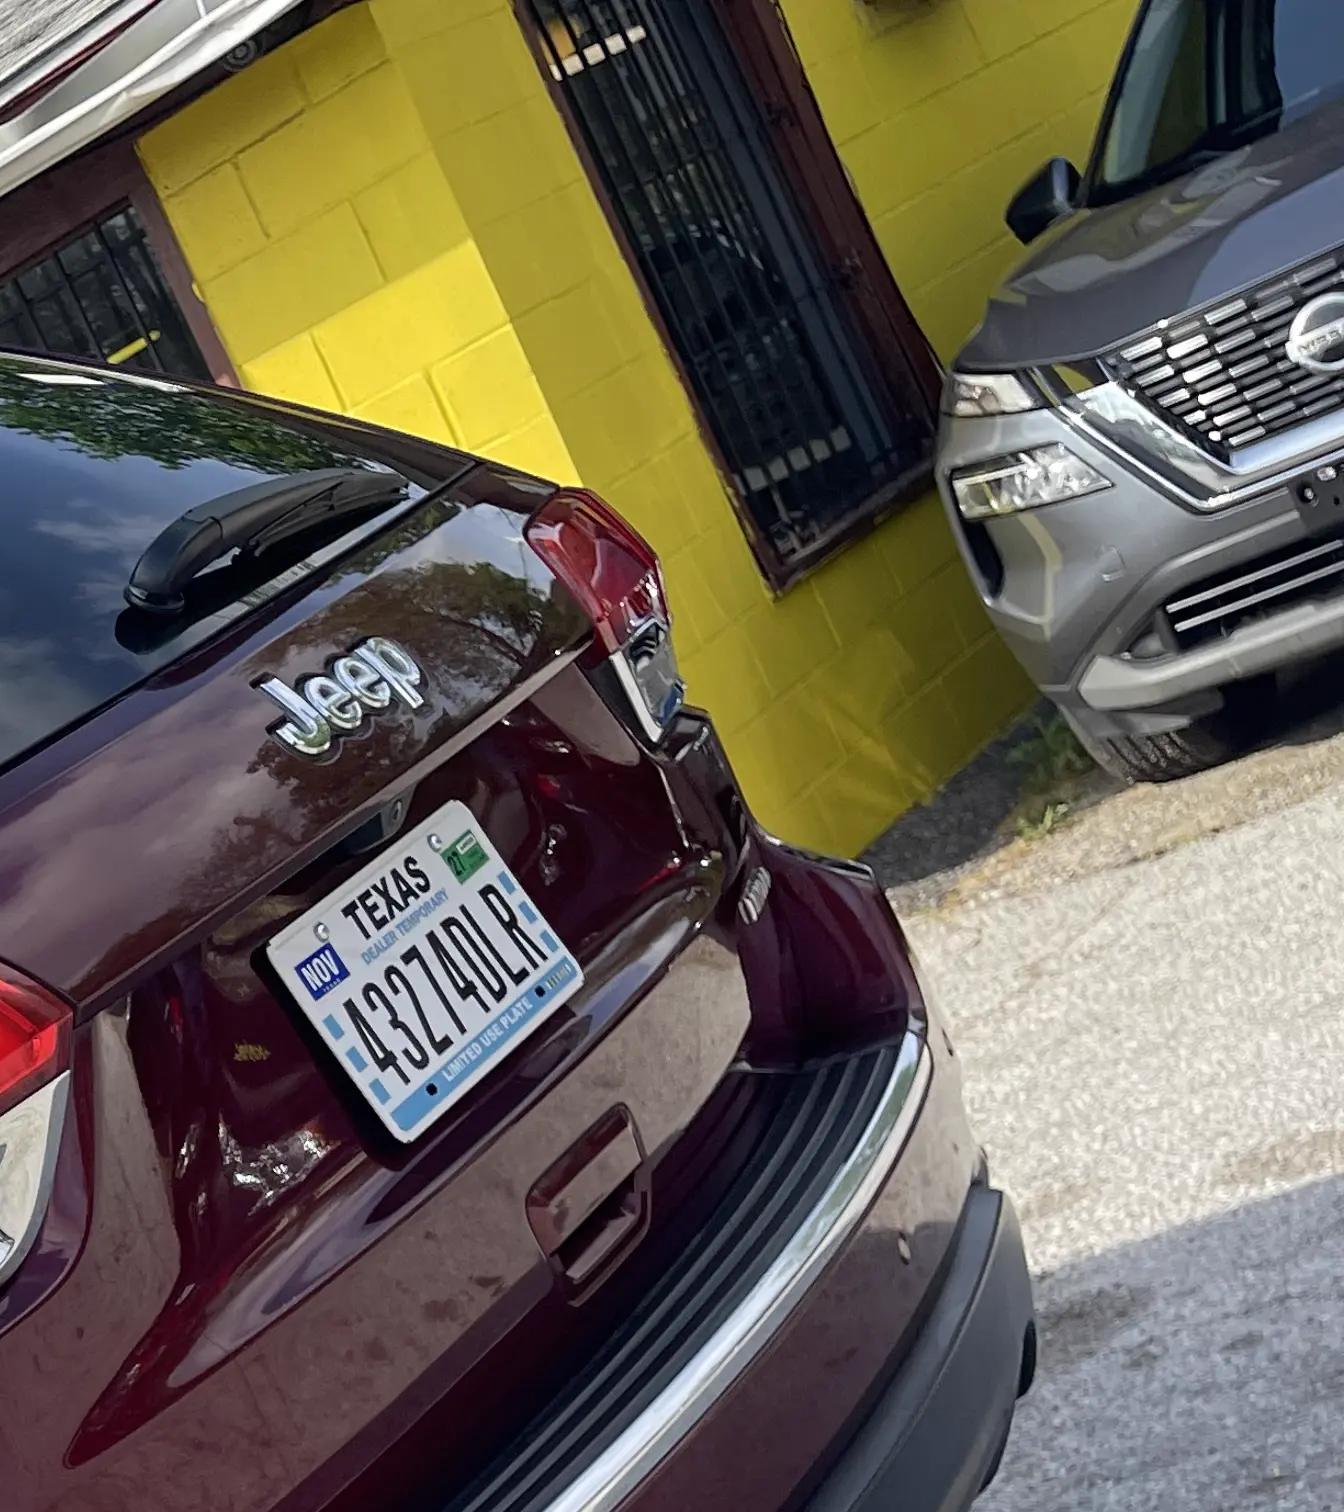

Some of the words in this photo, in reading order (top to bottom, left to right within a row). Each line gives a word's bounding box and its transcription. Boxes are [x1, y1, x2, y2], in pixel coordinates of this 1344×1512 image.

[258, 635, 426, 756] Jeep
[341, 856, 431, 941] TEXAS
[447, 850, 466, 877] 27
[360, 929, 399, 966] DEALER
[395, 887, 449, 937] TEMPORARY
[300, 948, 340, 992] NOV
[343, 882, 549, 1086] 43274DLR
[441, 1042, 483, 1082] LIMITED
[479, 1022, 505, 1048] USE
[499, 996, 534, 1030] PLATE
